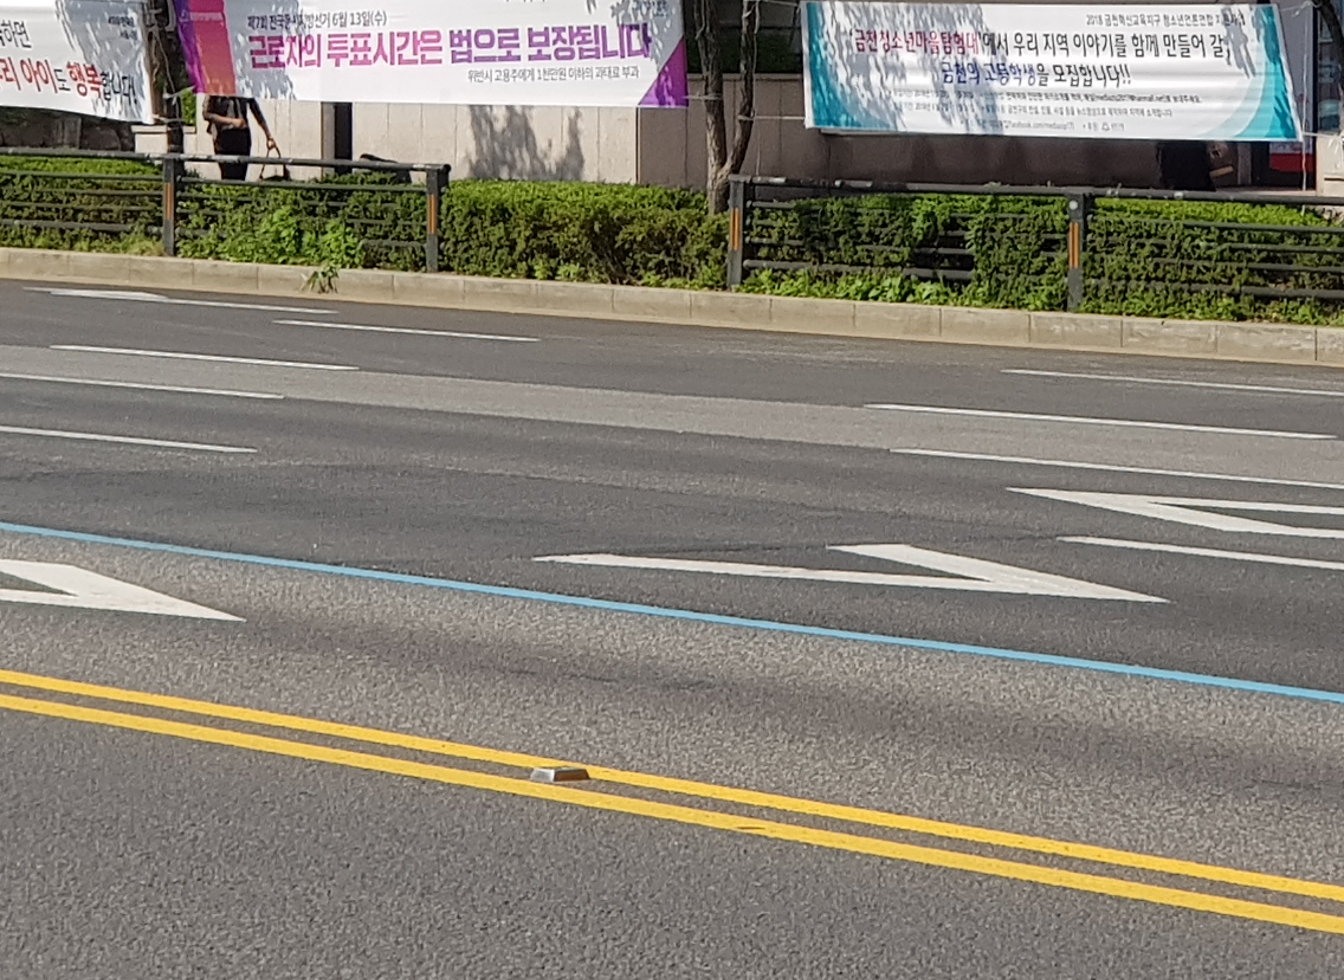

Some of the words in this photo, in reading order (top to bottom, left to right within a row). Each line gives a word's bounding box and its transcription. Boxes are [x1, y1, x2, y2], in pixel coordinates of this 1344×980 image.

[247, 14, 268, 30] 제7회
[332, 11, 348, 28] 6월
[349, 10, 388, 27] 13일(수)
[247, 32, 323, 69] 근로자의
[326, 28, 443, 68] 투표시간은
[448, 26, 522, 65] 법으로
[527, 21, 653, 62] 보장됩니다
[1013, 31, 1040, 58] 우리
[1042, 32, 1069, 59] 지역
[1072, 33, 1128, 59] 이야기를
[1130, 33, 1160, 58] 함께
[1162, 33, 1207, 59] 만들어
[23, 58, 72, 94] 아이도
[66, 59, 138, 107] 행복합니다!
[467, 69, 493, 84] 위반시
[494, 67, 536, 83] 고용주에게
[536, 66, 567, 81] 1천만원
[567, 65, 594, 81] 이하의
[594, 65, 621, 80] 과태료
[621, 64, 640, 79] 부과
[941, 61, 981, 86] 금천의
[982, 61, 1050, 87] 고등학생을
[1052, 63, 1131, 88] 모집합니다!!
